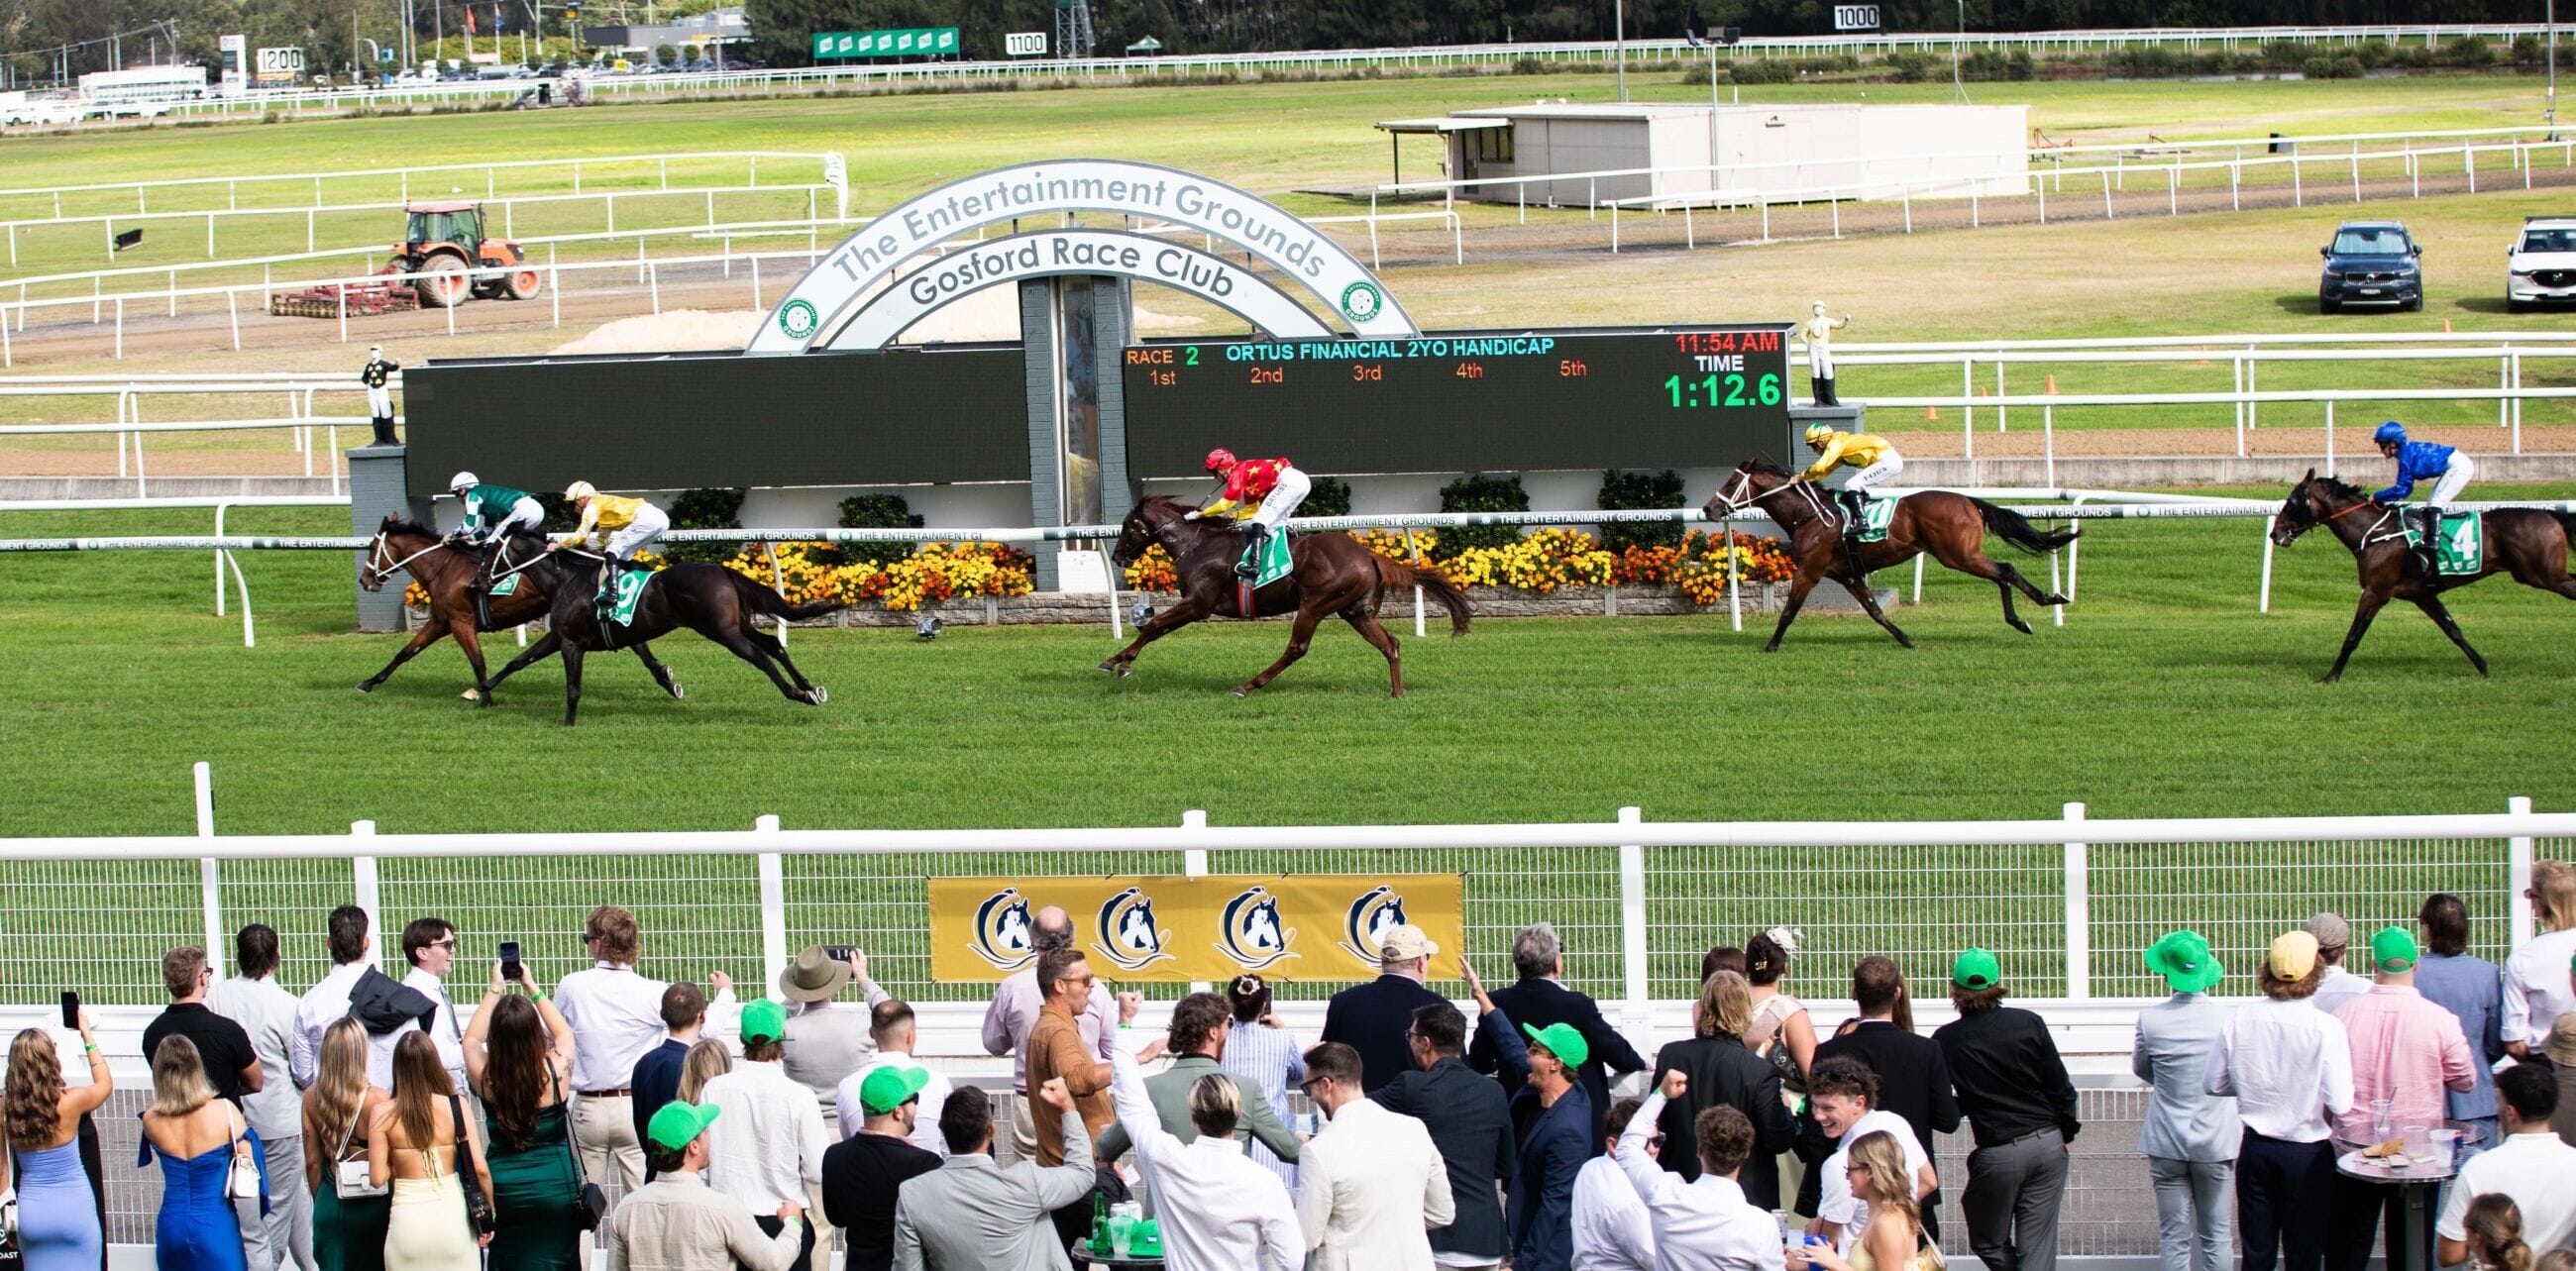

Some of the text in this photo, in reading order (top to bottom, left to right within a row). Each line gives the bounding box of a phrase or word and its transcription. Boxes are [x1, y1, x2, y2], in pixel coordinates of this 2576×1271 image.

[1838, 7, 1878, 26] 1000
[1011, 35, 1043, 53] 1100
[263, 50, 301, 69] 1200
[832, 171, 1326, 282] The Entertainment Grounds
[910, 237, 1234, 305] Gosford Race Club
[1226, 338, 1555, 362] ORTUS FINANCIAL 2YO HANDICAP
[1675, 332, 1779, 353] 11:54 AM
[1127, 347, 1200, 366] RACE 2
[1694, 355, 1744, 371] TIME
[1150, 360, 1587, 385] 1st 2nd 3rd 4th 5th
[1664, 373, 1781, 407] 1:12.6
[1500, 511, 1672, 524] THE ENTERTAINMENT GROUNDS
[2056, 507, 2112, 517] GROUNDS
[2157, 506, 2273, 516] THE ENTERTAINMENT
[1310, 517, 1397, 528] ENTERTAINMENT
[1401, 515, 1455, 526] GROUNDS
[679, 530, 761, 542] ENTERTAINMENT
[764, 530, 816, 541] GROUNDS
[882, 531, 967, 541] ENTERTAINMENT
[1076, 528, 1096, 537] THE
[2452, 518, 2478, 561] 4
[26, 540, 69, 550] GROUNDS
[104, 540, 121, 549] THE
[123, 539, 195, 549] ENTERTAINMENT
[278, 538, 298, 548] THE
[617, 573, 640, 608] 9
